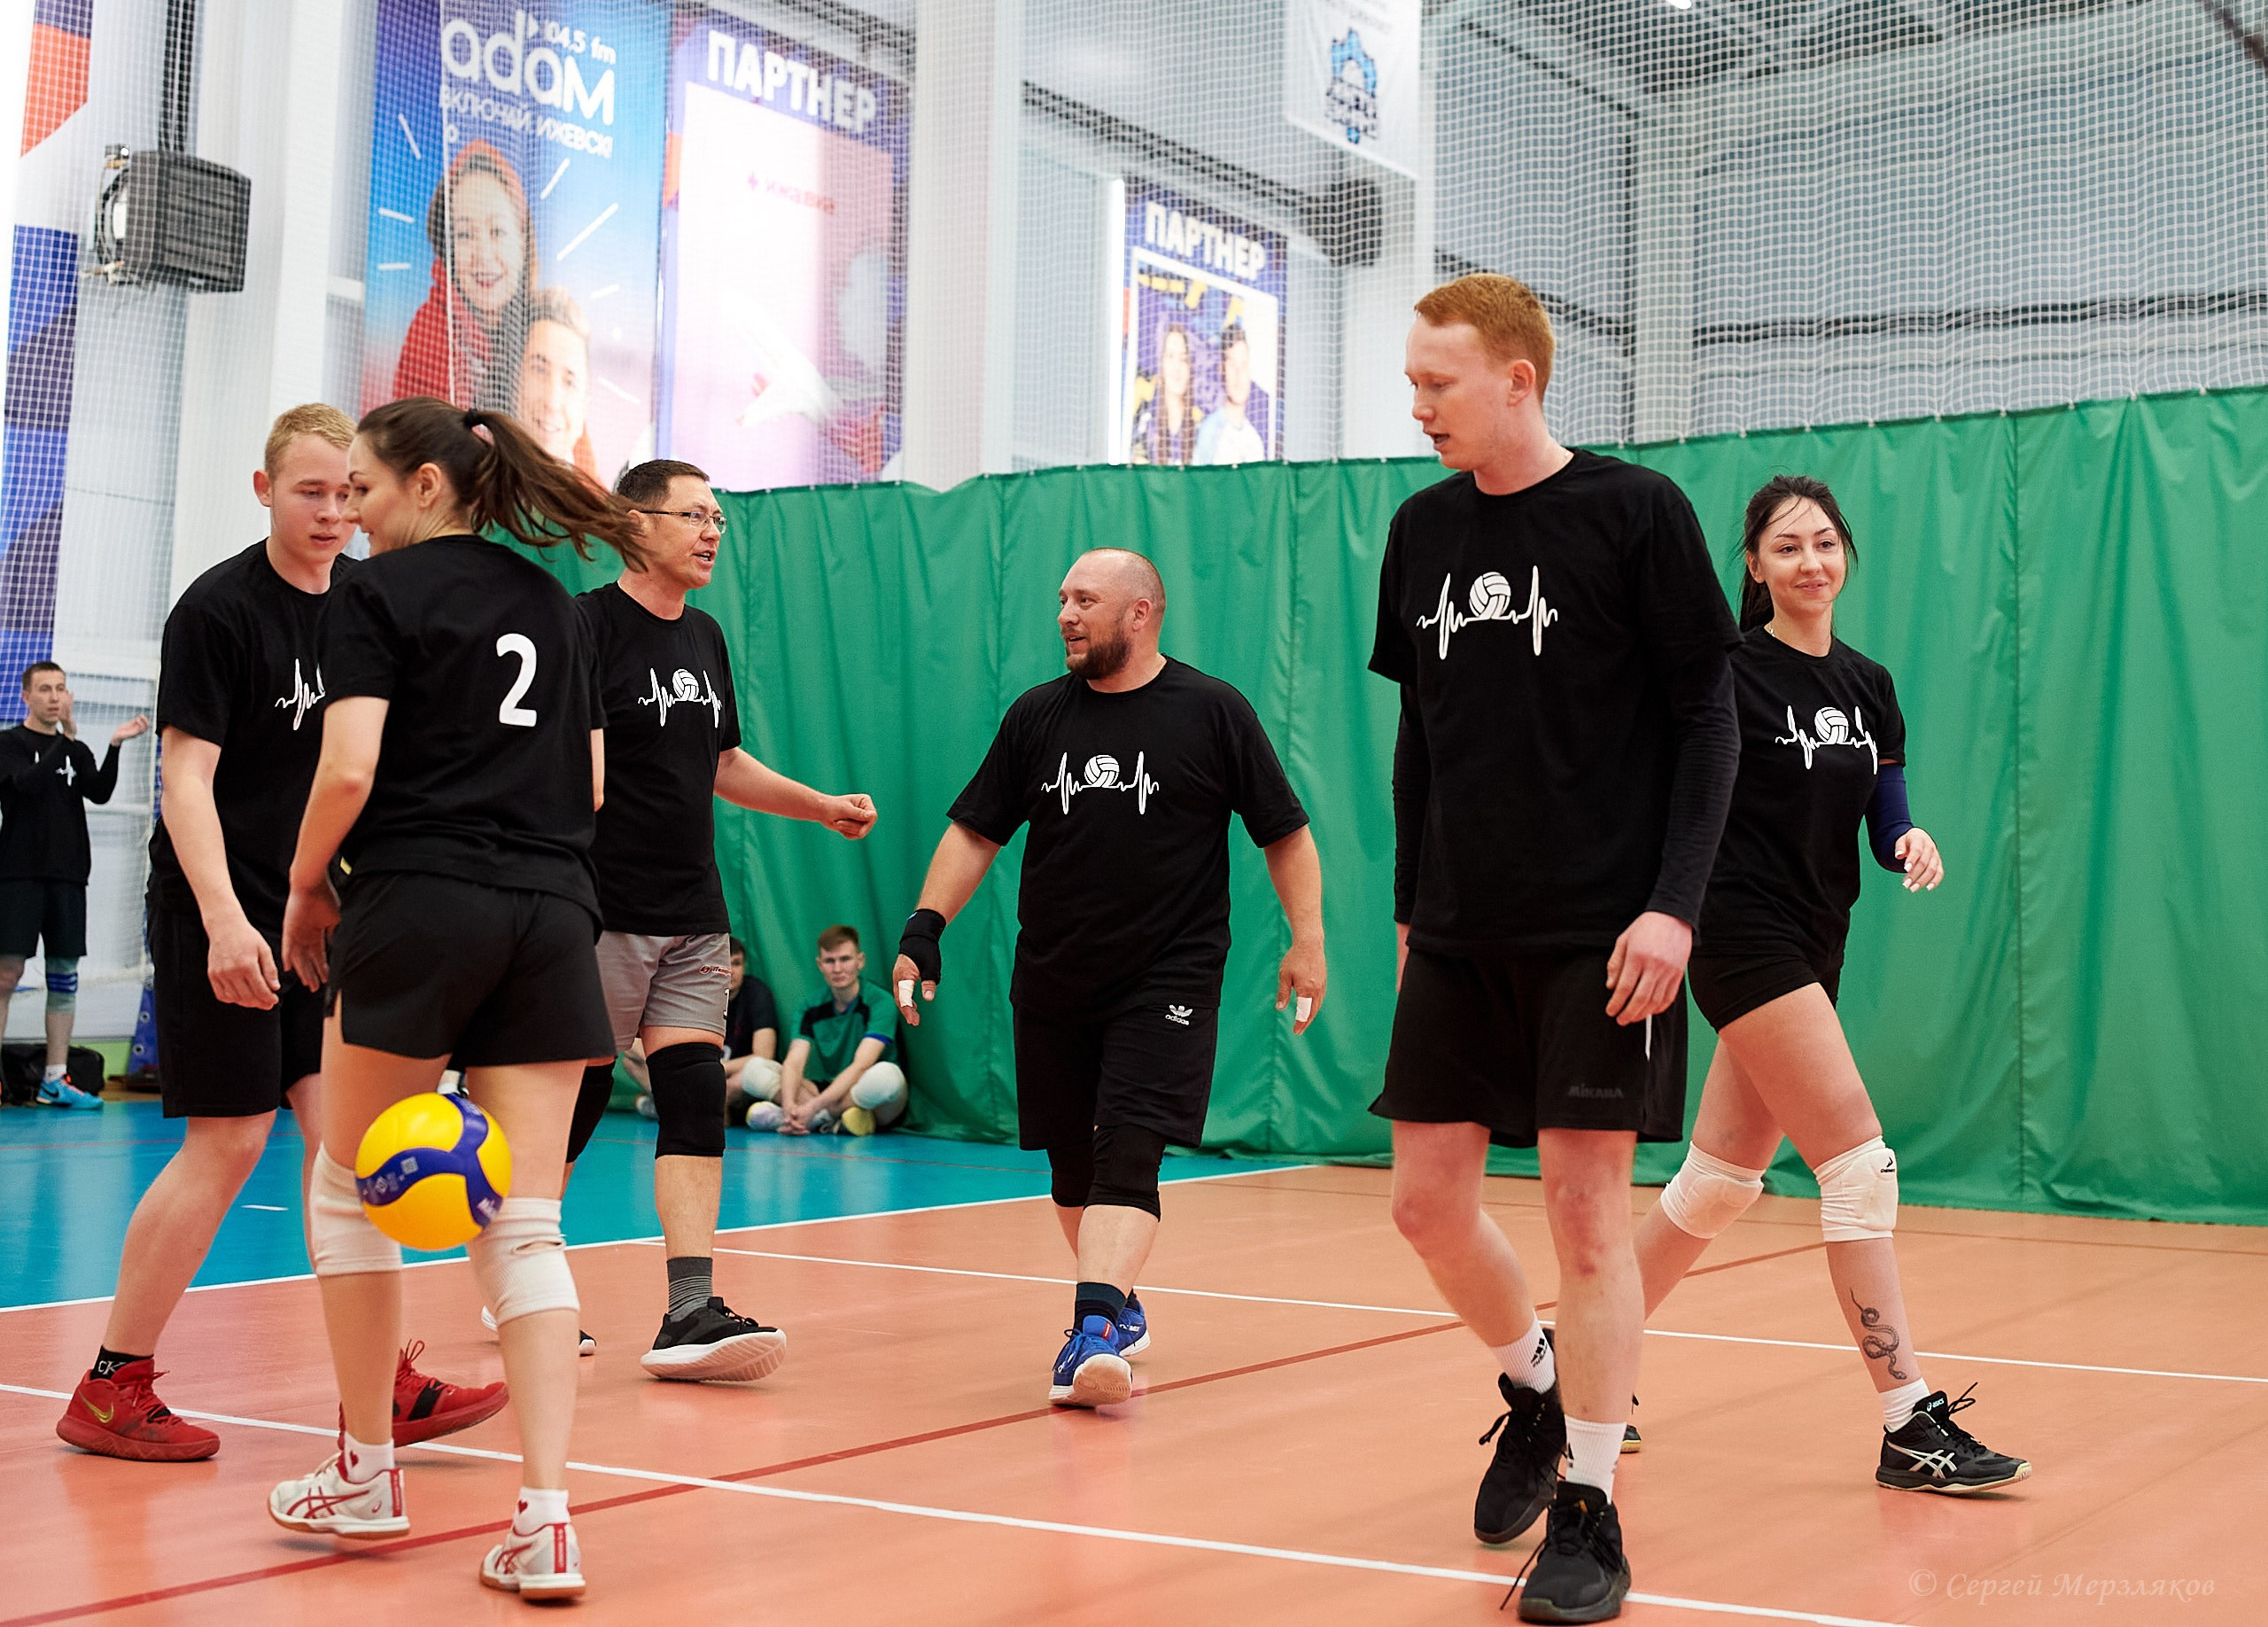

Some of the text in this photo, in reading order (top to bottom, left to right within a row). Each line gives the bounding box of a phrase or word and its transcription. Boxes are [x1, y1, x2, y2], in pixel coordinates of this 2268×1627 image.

[591, 36, 617, 65] fm
[707, 29, 877, 134] ПАРТНЕР
[1145, 201, 1266, 282] ПАРТНЕР
[496, 633, 537, 727] 2
[1165, 1014, 1189, 1025] adidas
[97, 1360, 127, 1375] CK
